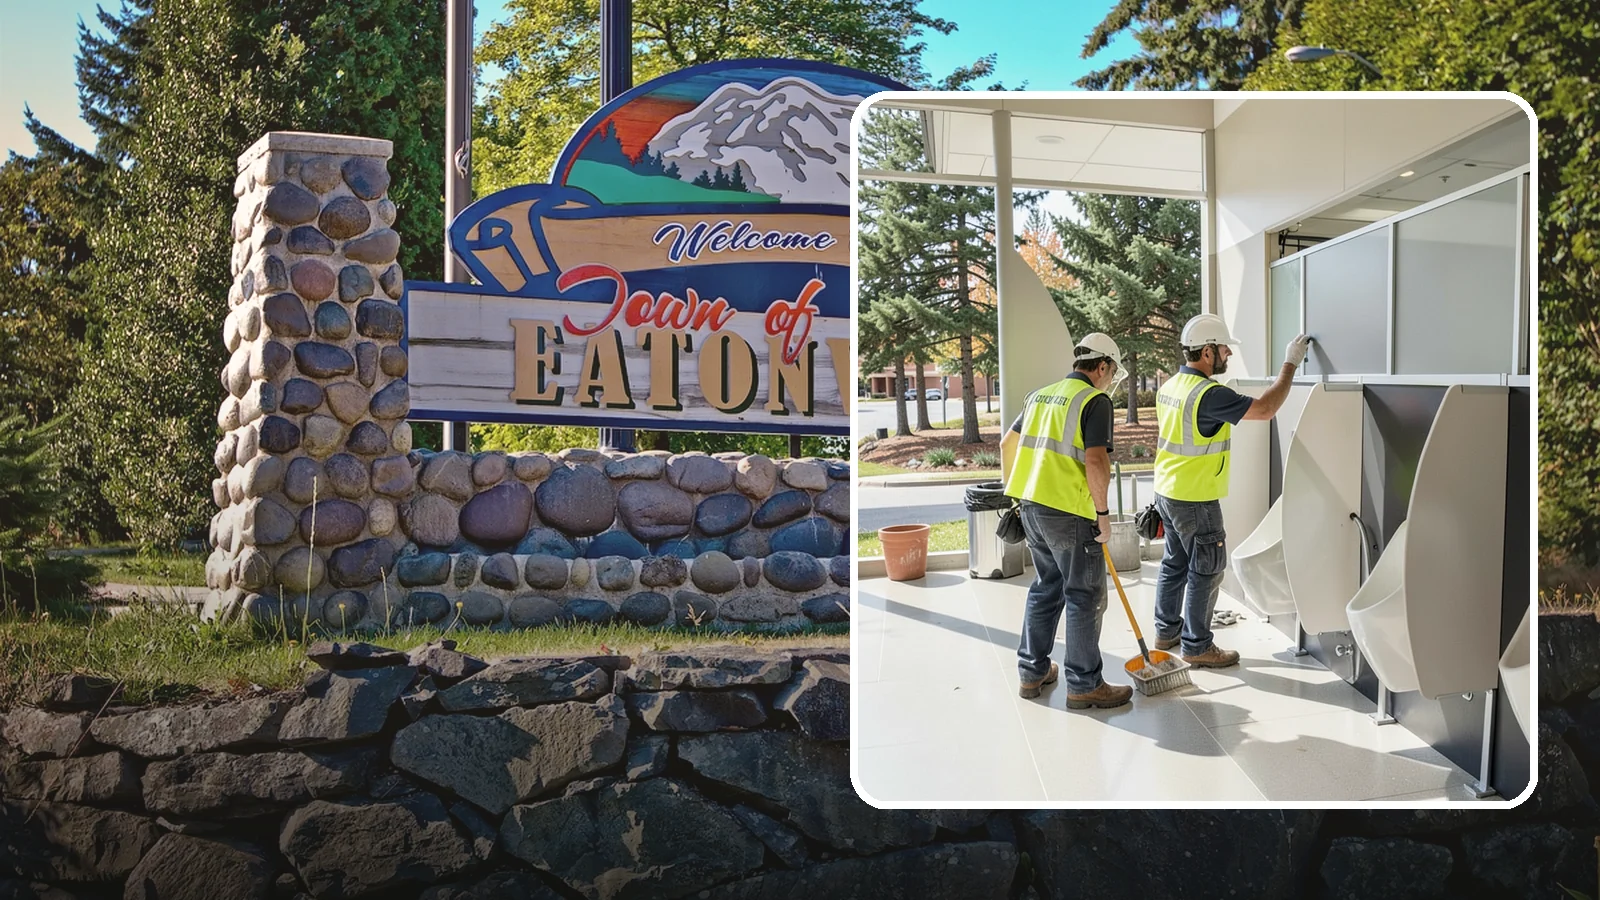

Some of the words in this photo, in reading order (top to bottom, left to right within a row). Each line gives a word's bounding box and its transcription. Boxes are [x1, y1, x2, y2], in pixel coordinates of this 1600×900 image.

[653, 220, 837, 263] Welcome
[556, 263, 737, 336] Town
[764, 278, 826, 365] of
